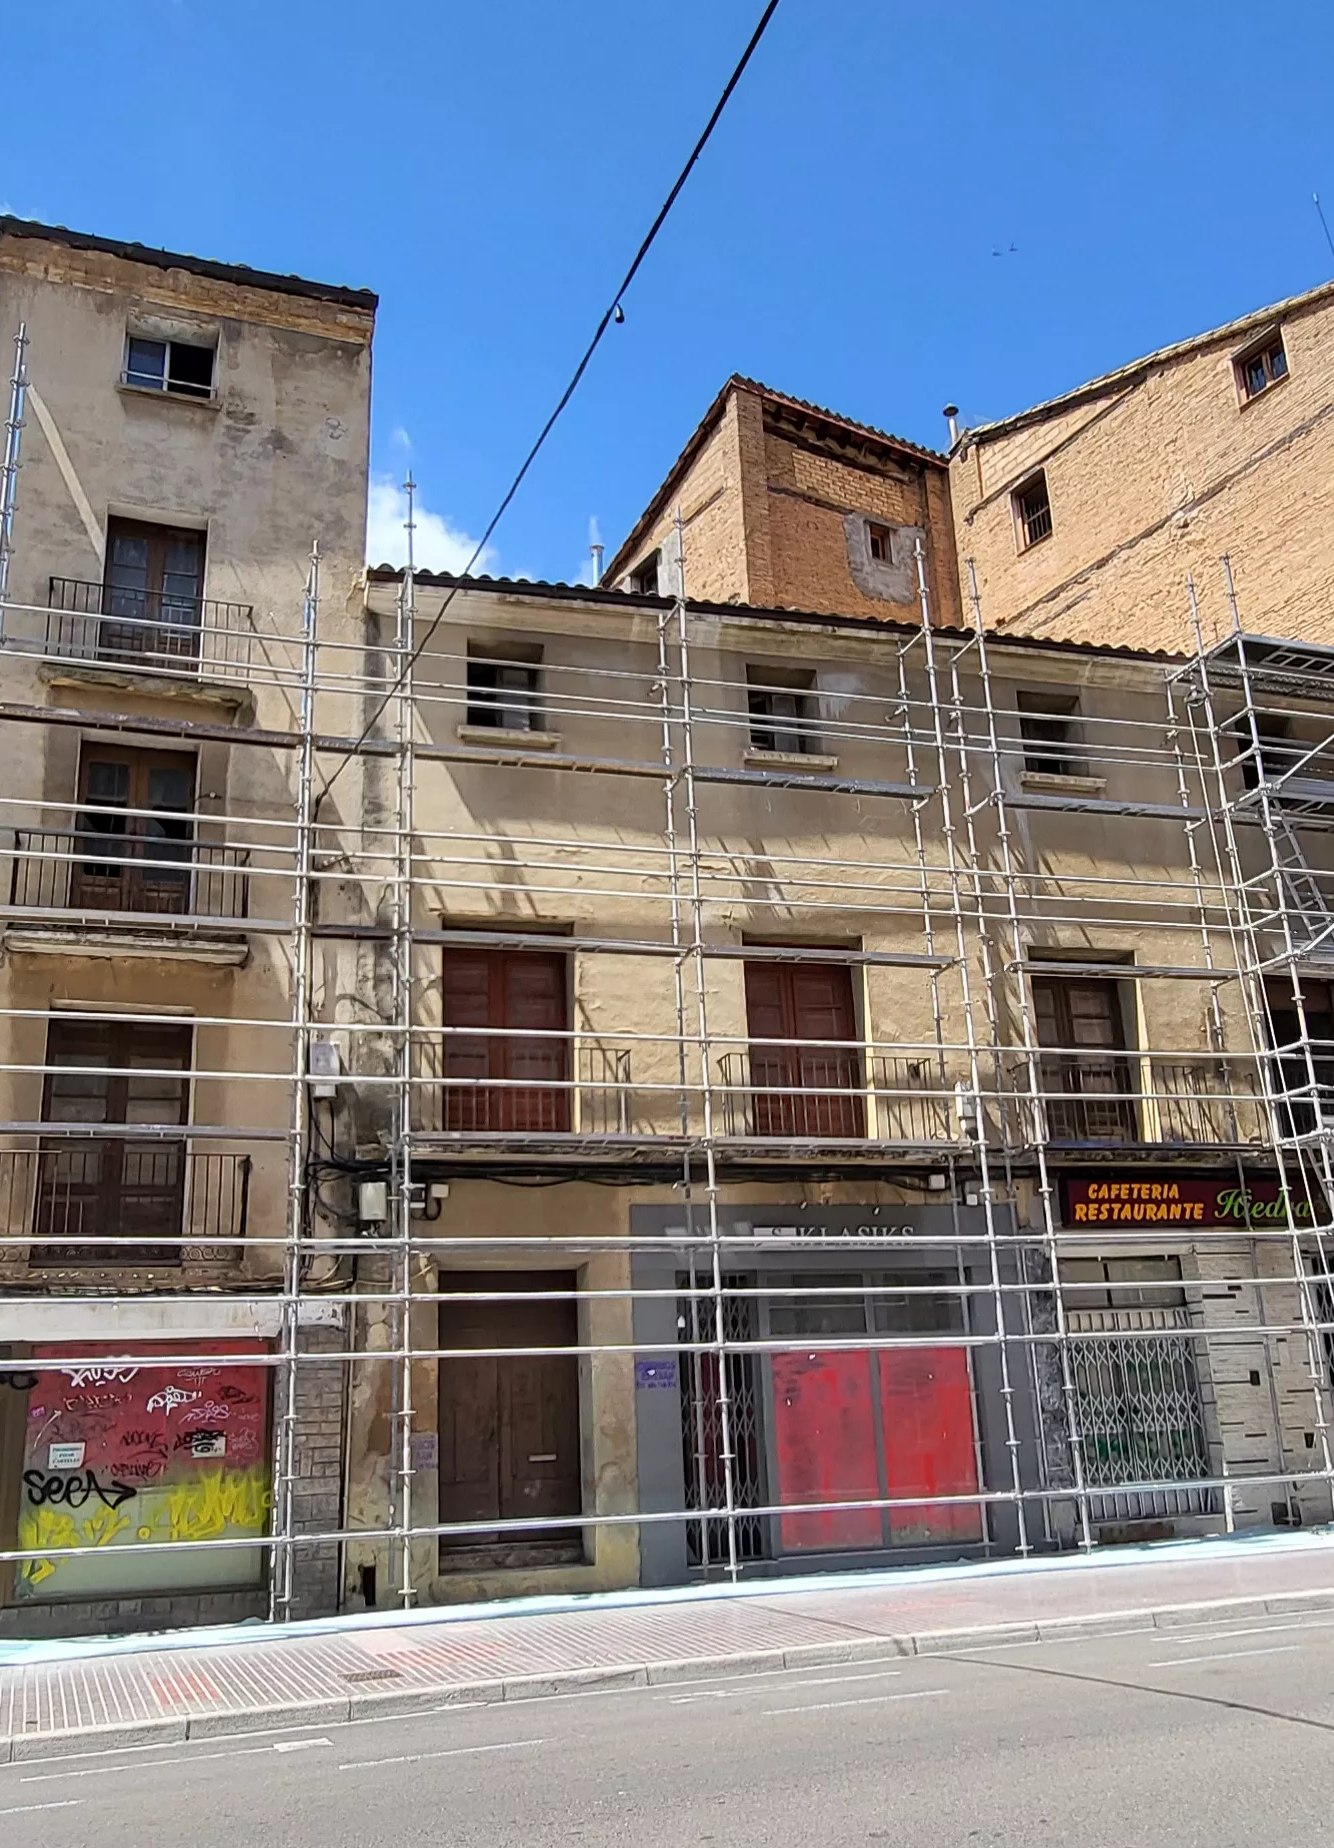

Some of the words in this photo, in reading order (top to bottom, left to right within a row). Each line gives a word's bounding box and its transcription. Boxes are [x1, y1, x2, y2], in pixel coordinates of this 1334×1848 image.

[1088, 1183, 1180, 1200] CAFETERIA
[1074, 1203, 1204, 1221] RESTAURANTE
[1214, 1188, 1311, 1219] Heda
